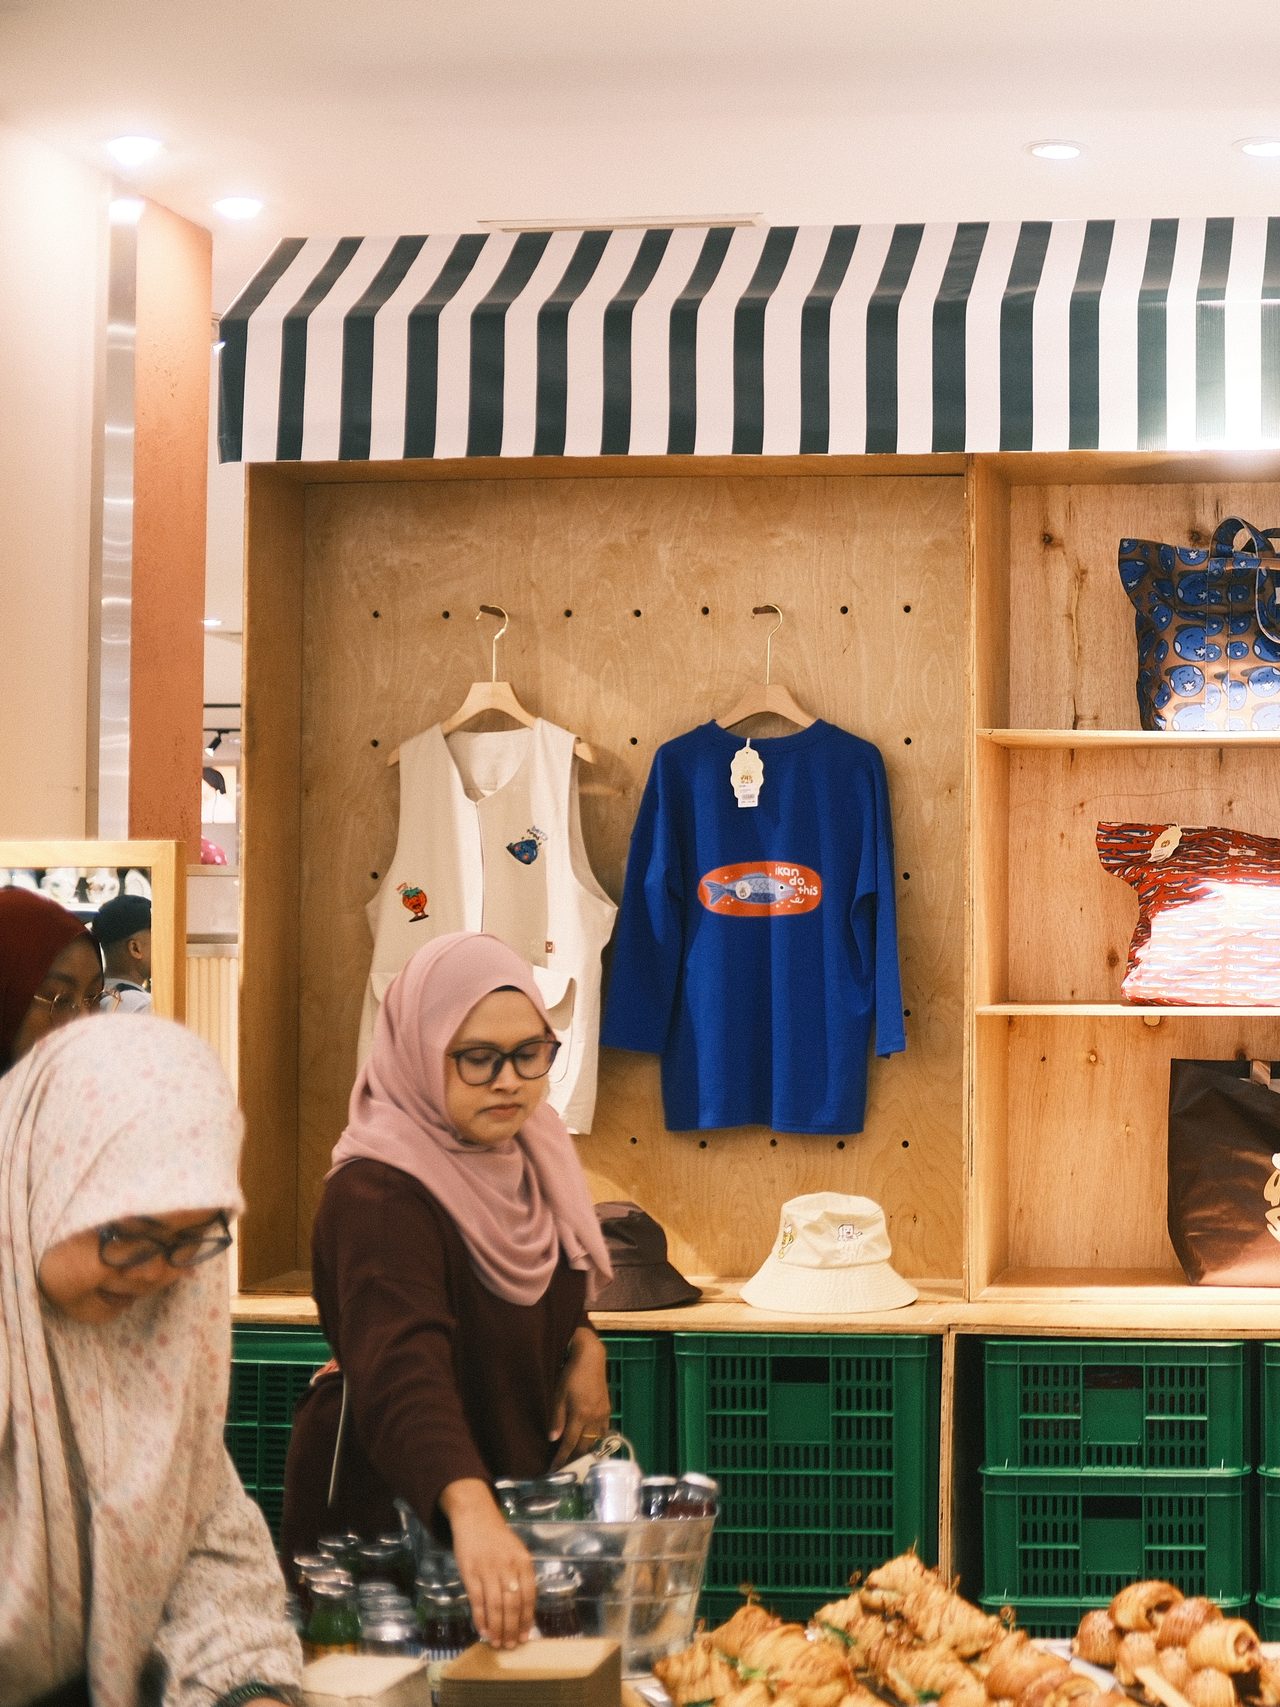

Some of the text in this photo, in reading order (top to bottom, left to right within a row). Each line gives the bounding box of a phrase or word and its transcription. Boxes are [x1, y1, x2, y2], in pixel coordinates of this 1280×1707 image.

[774, 864, 800, 877] ikan
[788, 875, 805, 886] do
[797, 884, 819, 896] this
